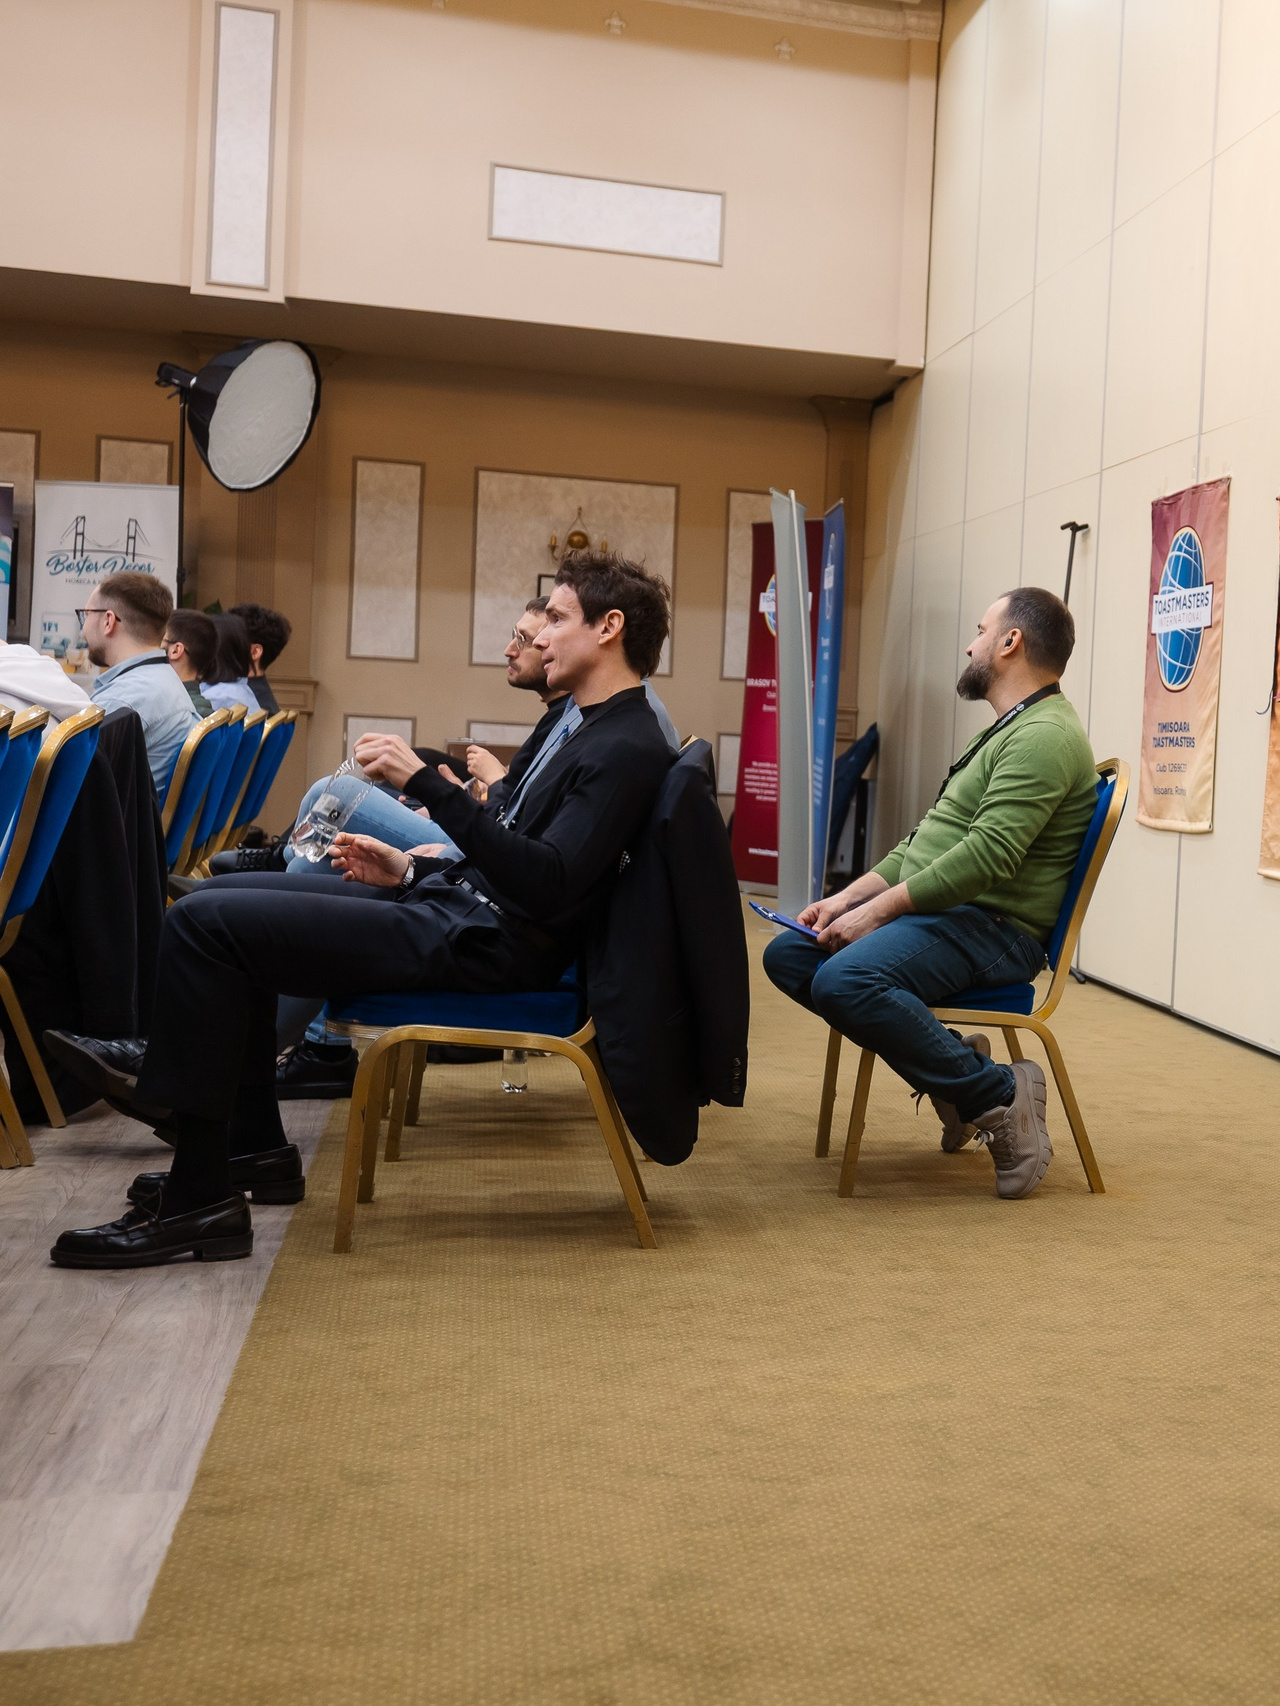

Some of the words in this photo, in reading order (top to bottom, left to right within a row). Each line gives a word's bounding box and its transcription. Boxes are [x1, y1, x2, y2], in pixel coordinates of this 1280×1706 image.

[1154, 591, 1210, 615] TOASTMASTERS
[1158, 611, 1202, 628] INTERNATIONAL
[1157, 721, 1190, 734] TIMISOARA
[1152, 736, 1195, 748] TOASTMASTERS
